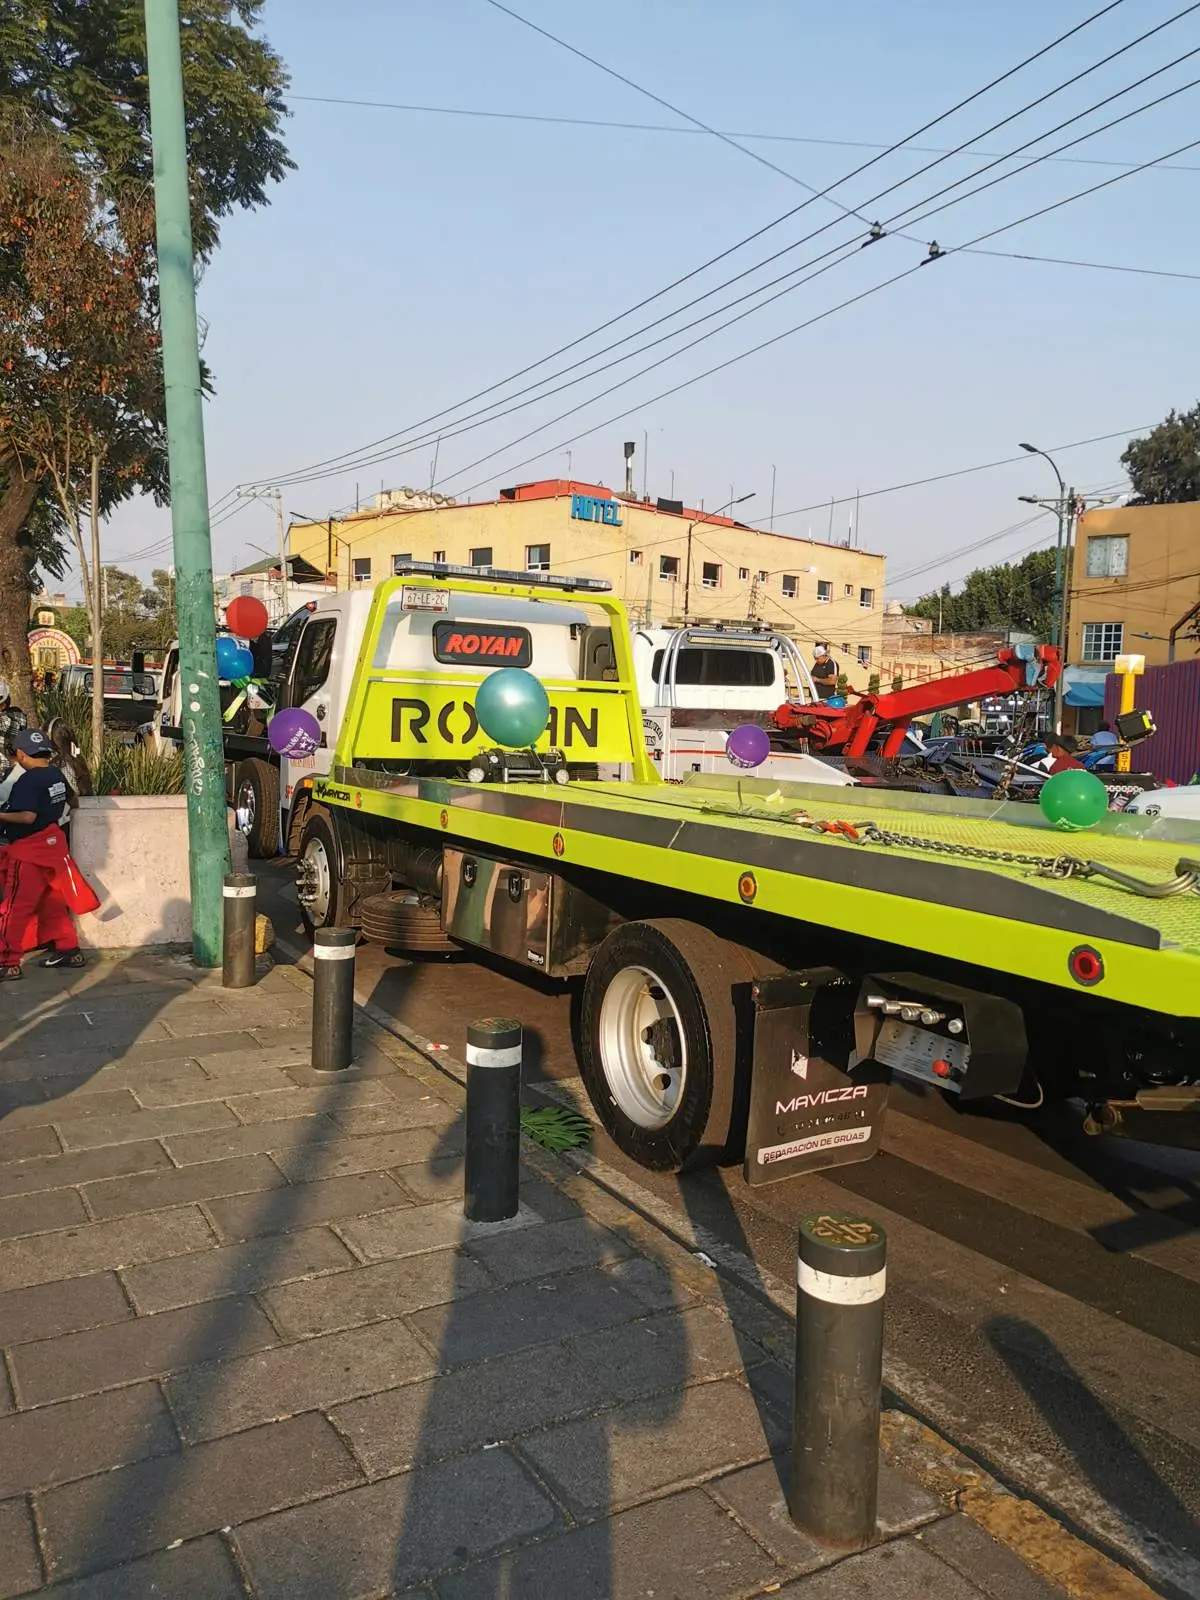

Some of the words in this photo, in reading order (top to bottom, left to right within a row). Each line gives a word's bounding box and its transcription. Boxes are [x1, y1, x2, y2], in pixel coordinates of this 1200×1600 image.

[571, 494, 623, 527] HOTEL
[445, 633, 524, 657] ROYAN
[880, 661, 934, 683] HOTEL
[775, 1085, 868, 1115] MAVICZA
[820, 1137, 833, 1147] DE
